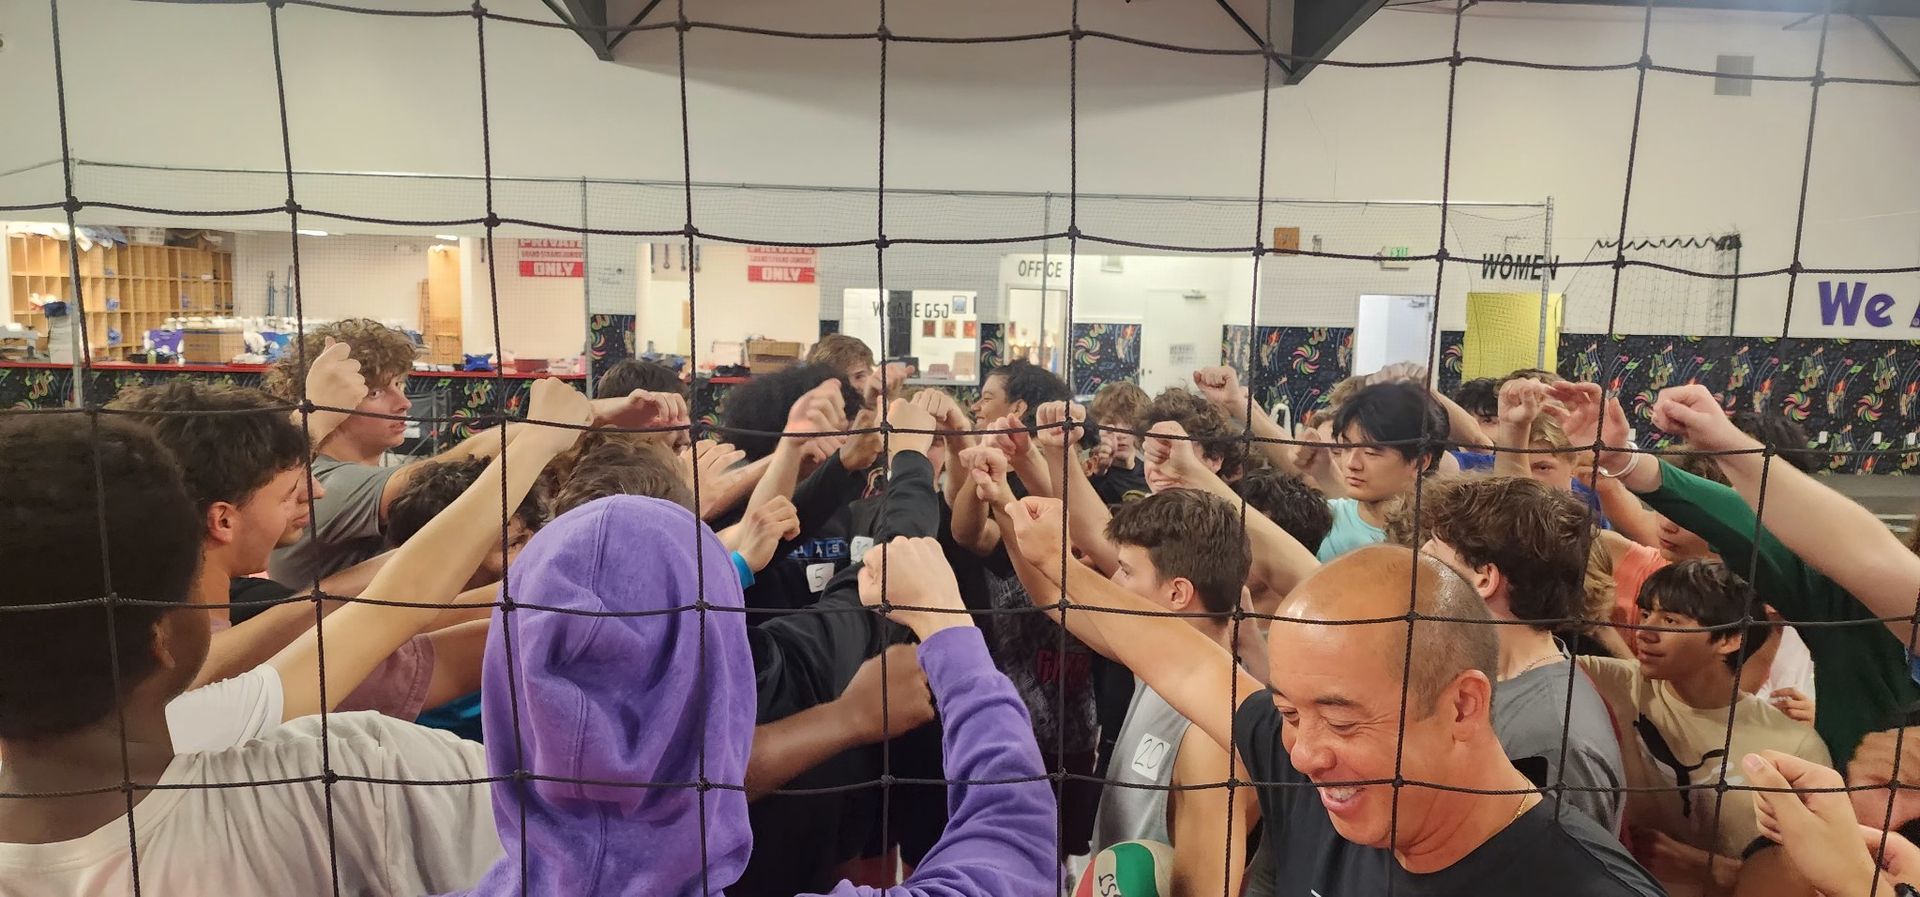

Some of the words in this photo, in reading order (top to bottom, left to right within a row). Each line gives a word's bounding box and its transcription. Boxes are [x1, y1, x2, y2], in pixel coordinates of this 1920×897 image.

[534, 261, 575, 276] ONLY
[762, 267, 801, 281] ONLY
[1018, 260, 1062, 278] OFFCE
[1482, 253, 1559, 280] WOMEN
[1818, 281, 1896, 327] We
[1134, 738, 1165, 770] 20
